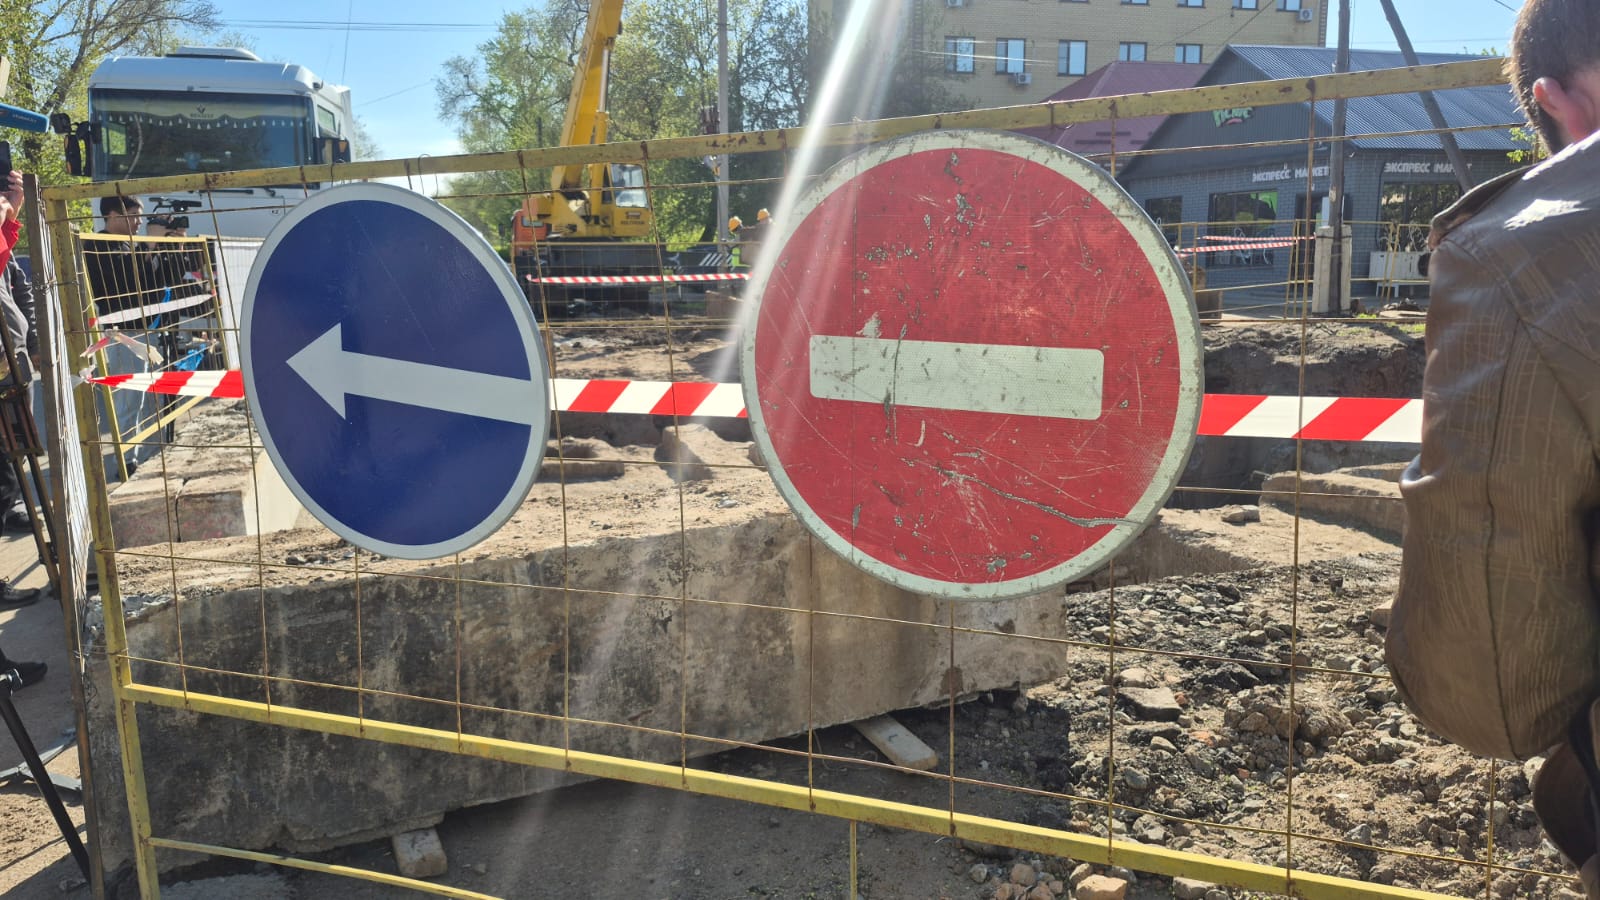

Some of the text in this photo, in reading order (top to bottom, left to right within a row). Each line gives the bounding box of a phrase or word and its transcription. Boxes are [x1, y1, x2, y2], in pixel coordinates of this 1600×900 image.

[1252, 166, 1330, 183] ЭКСПРЕСС МАКЕТ
[1384, 162, 1473, 174] ЭКСПРЕСС МАРТ
